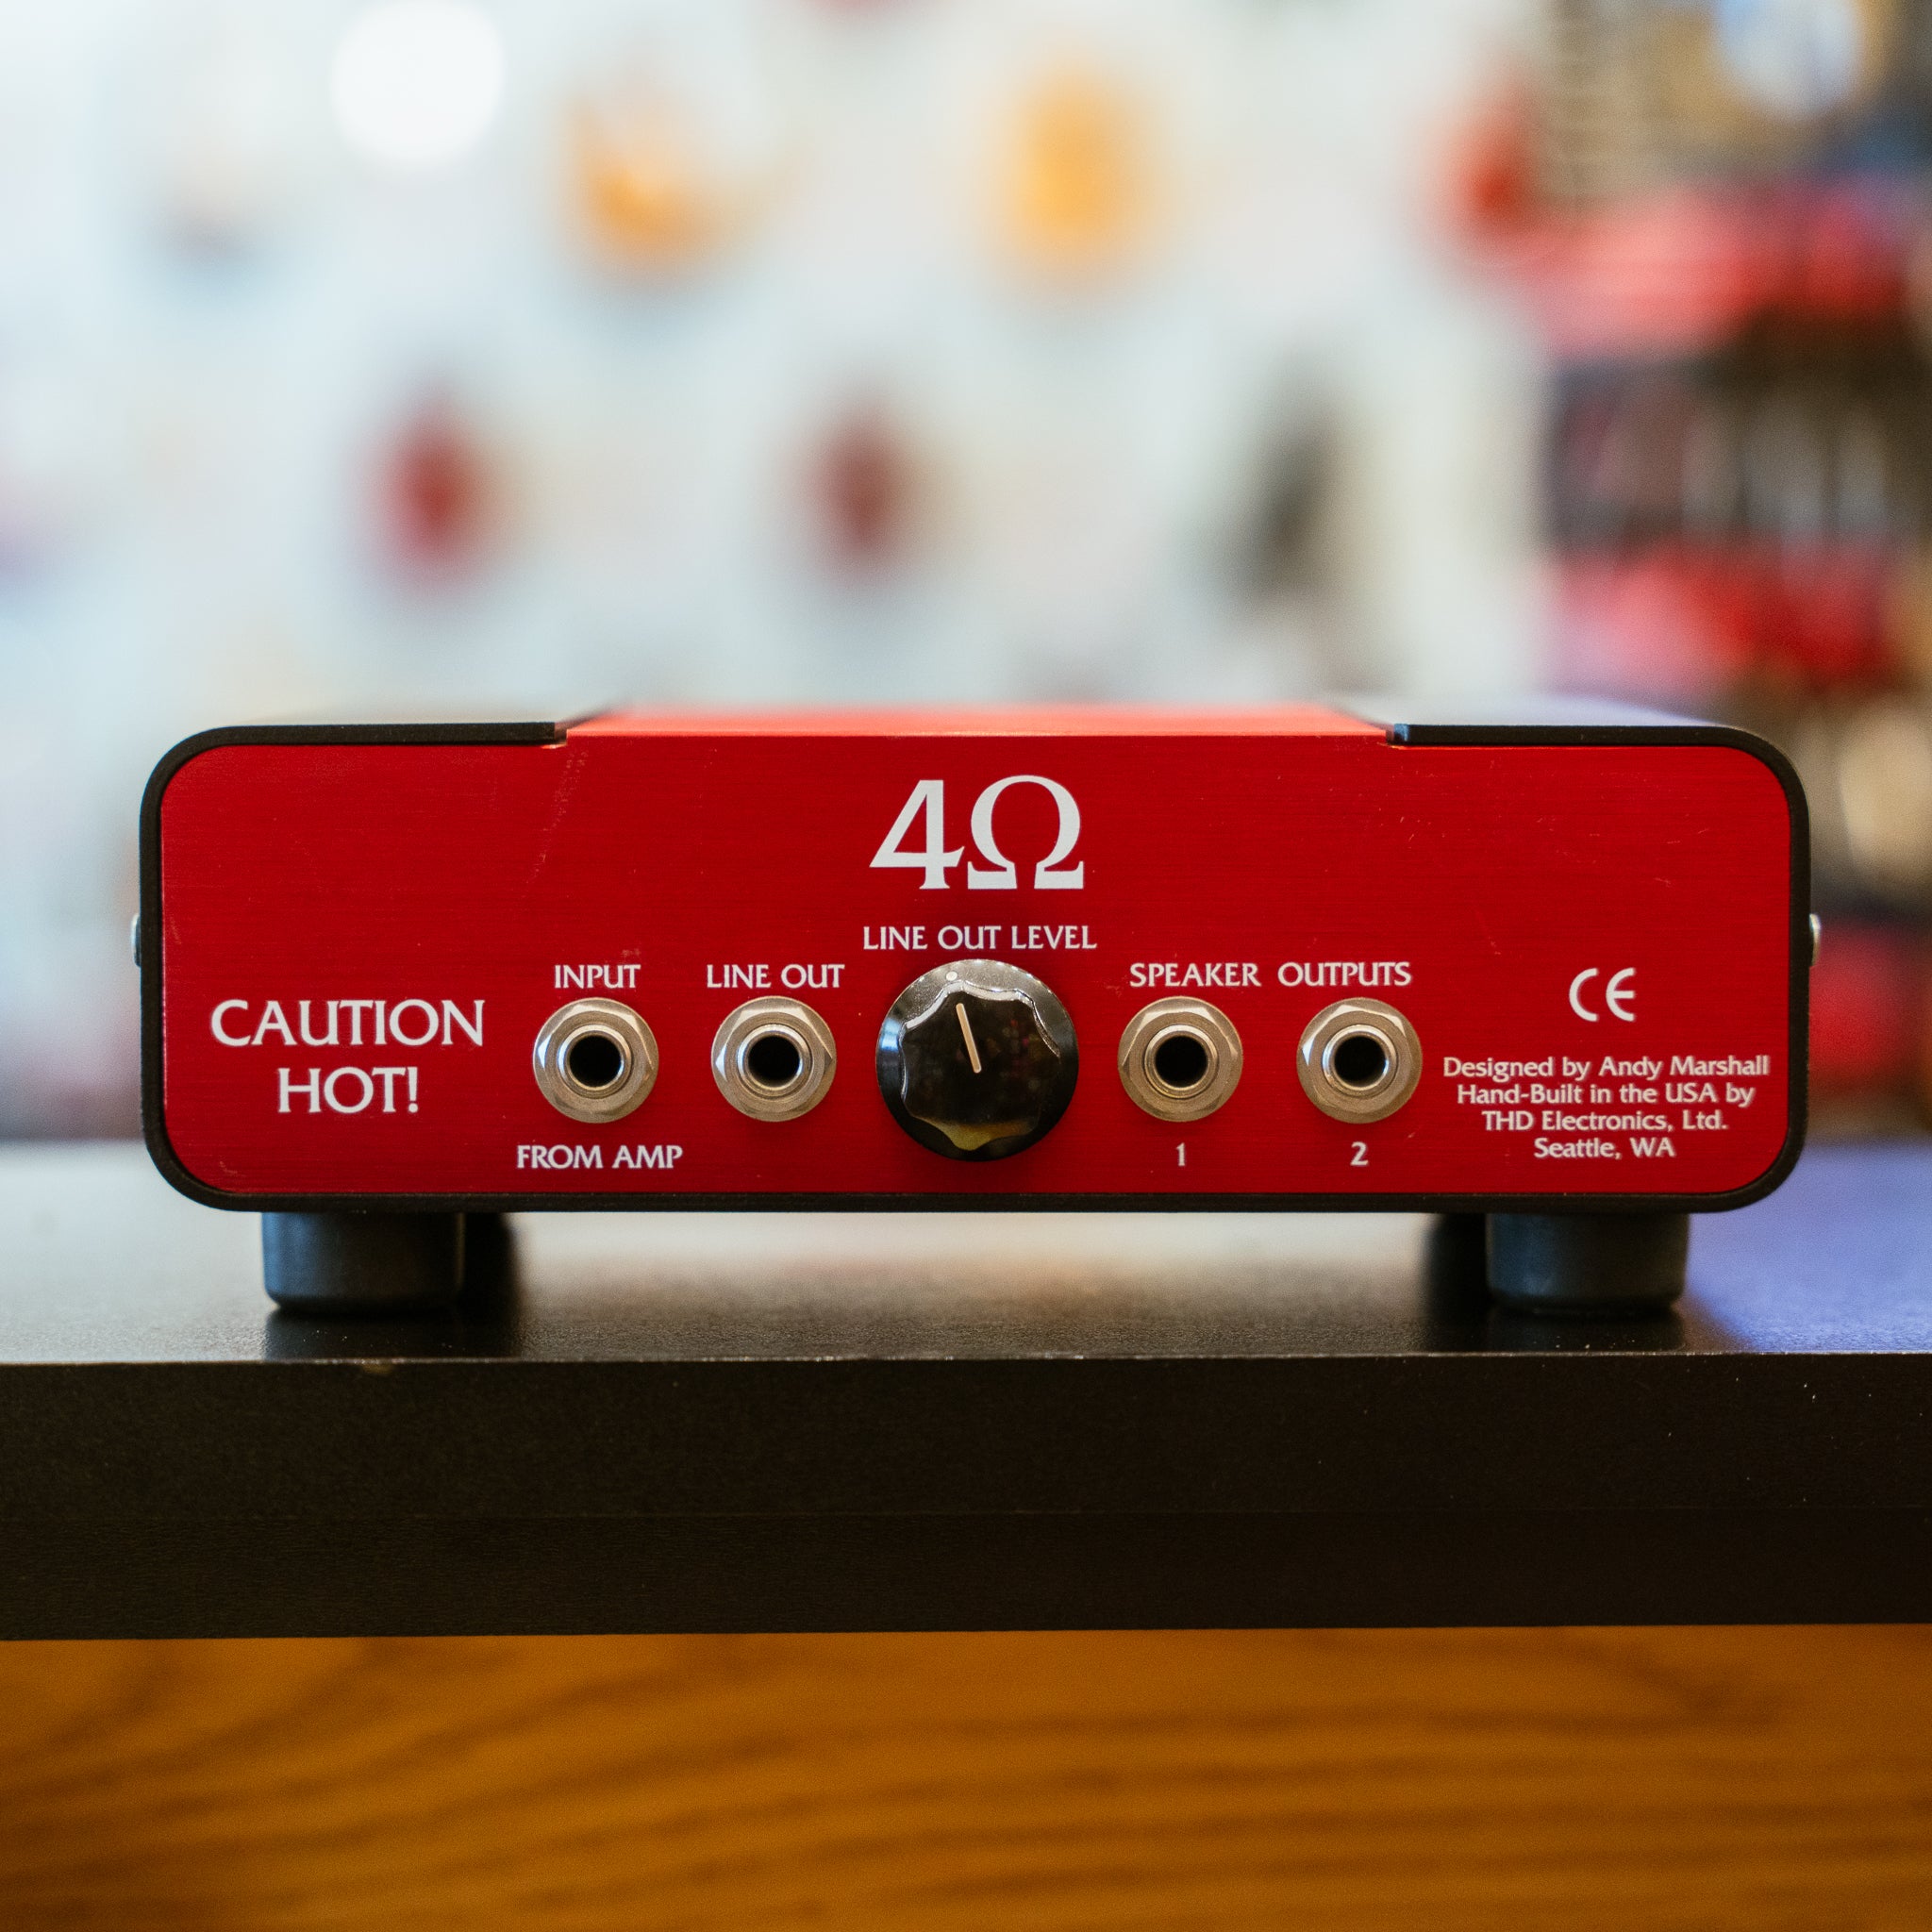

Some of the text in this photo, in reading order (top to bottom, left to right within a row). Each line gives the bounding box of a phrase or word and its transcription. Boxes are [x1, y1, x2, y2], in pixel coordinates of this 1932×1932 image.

[863, 924, 1097, 951] LINE OUT LEVEL
[554, 963, 641, 990] INPUT
[707, 963, 845, 989] LINE OUT
[1129, 961, 1412, 988] SPEAKER OUTPUTS
[1568, 967, 1636, 1023] CE
[210, 998, 486, 1047] CAUTION
[1443, 1055, 1769, 1083] Designed by Andy Marshall
[277, 1066, 419, 1114] HOT!
[1457, 1082, 1755, 1108] Hand-Built in the USA by
[1481, 1109, 1727, 1132] THD Electronics, Ltd.
[517, 1144, 683, 1170] FROM AMP
[1175, 1142, 1187, 1168] 1
[1350, 1141, 1369, 1167] 2
[1534, 1137, 1675, 1159] Seattle, WA
